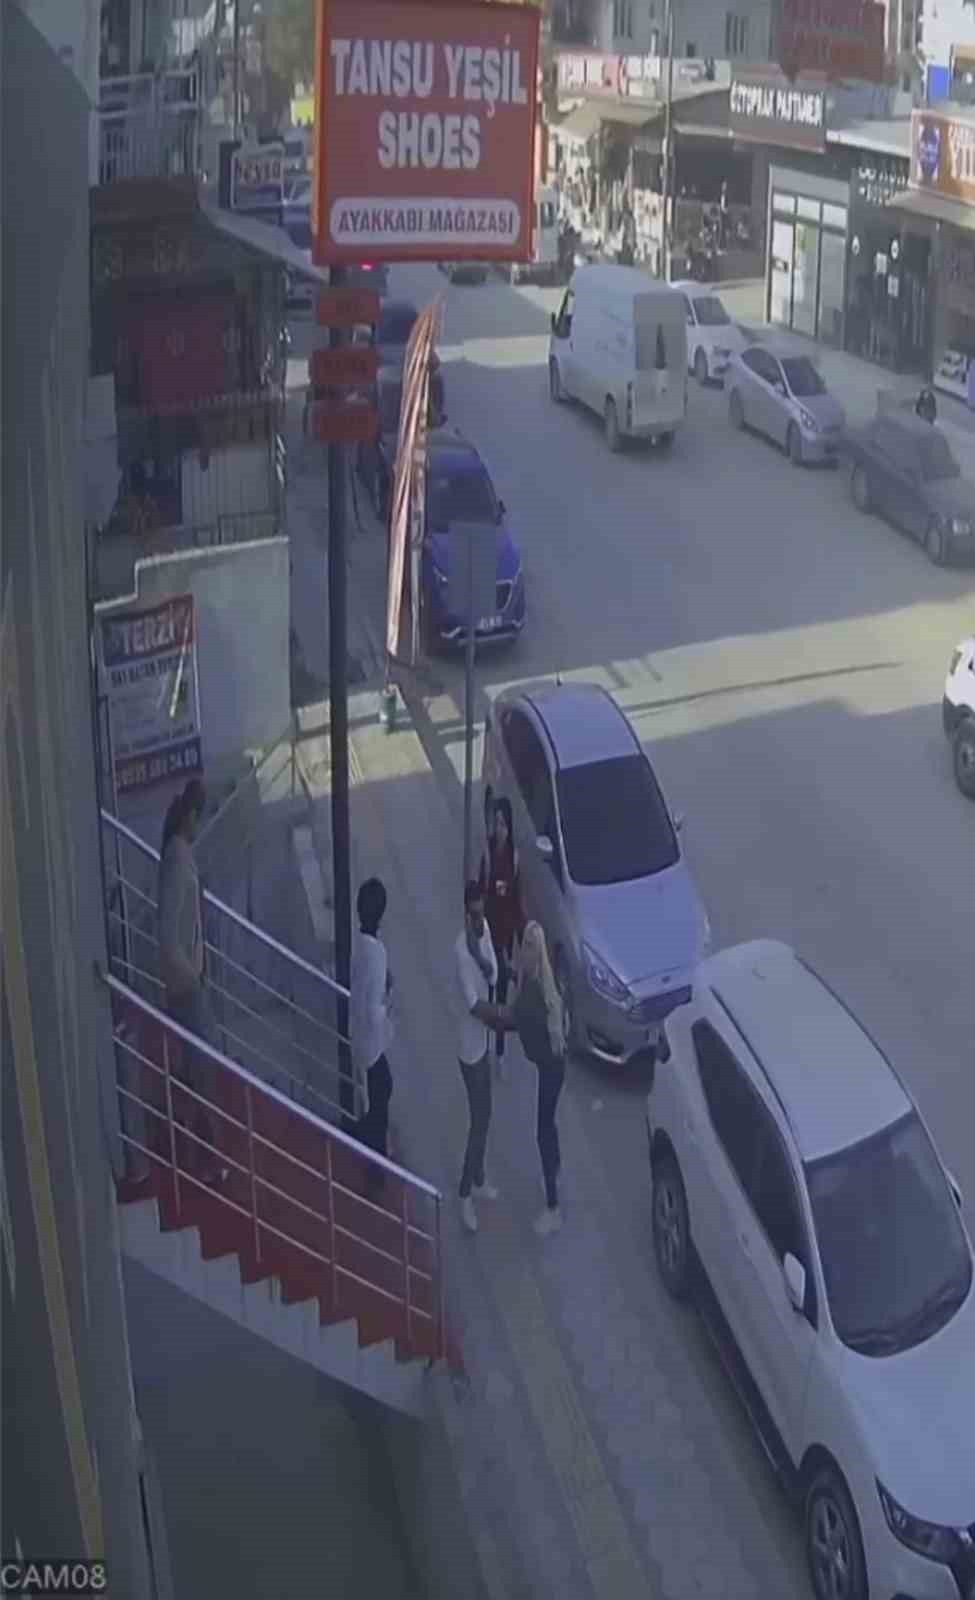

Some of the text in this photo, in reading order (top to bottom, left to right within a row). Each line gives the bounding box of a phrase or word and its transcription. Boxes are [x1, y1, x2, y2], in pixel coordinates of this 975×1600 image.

[330, 38, 435, 98] TANSU
[443, 33, 528, 118] YEŞİL
[377, 110, 481, 169] SHOES
[338, 206, 513, 234] AYAKKABI MAĞAZASI
